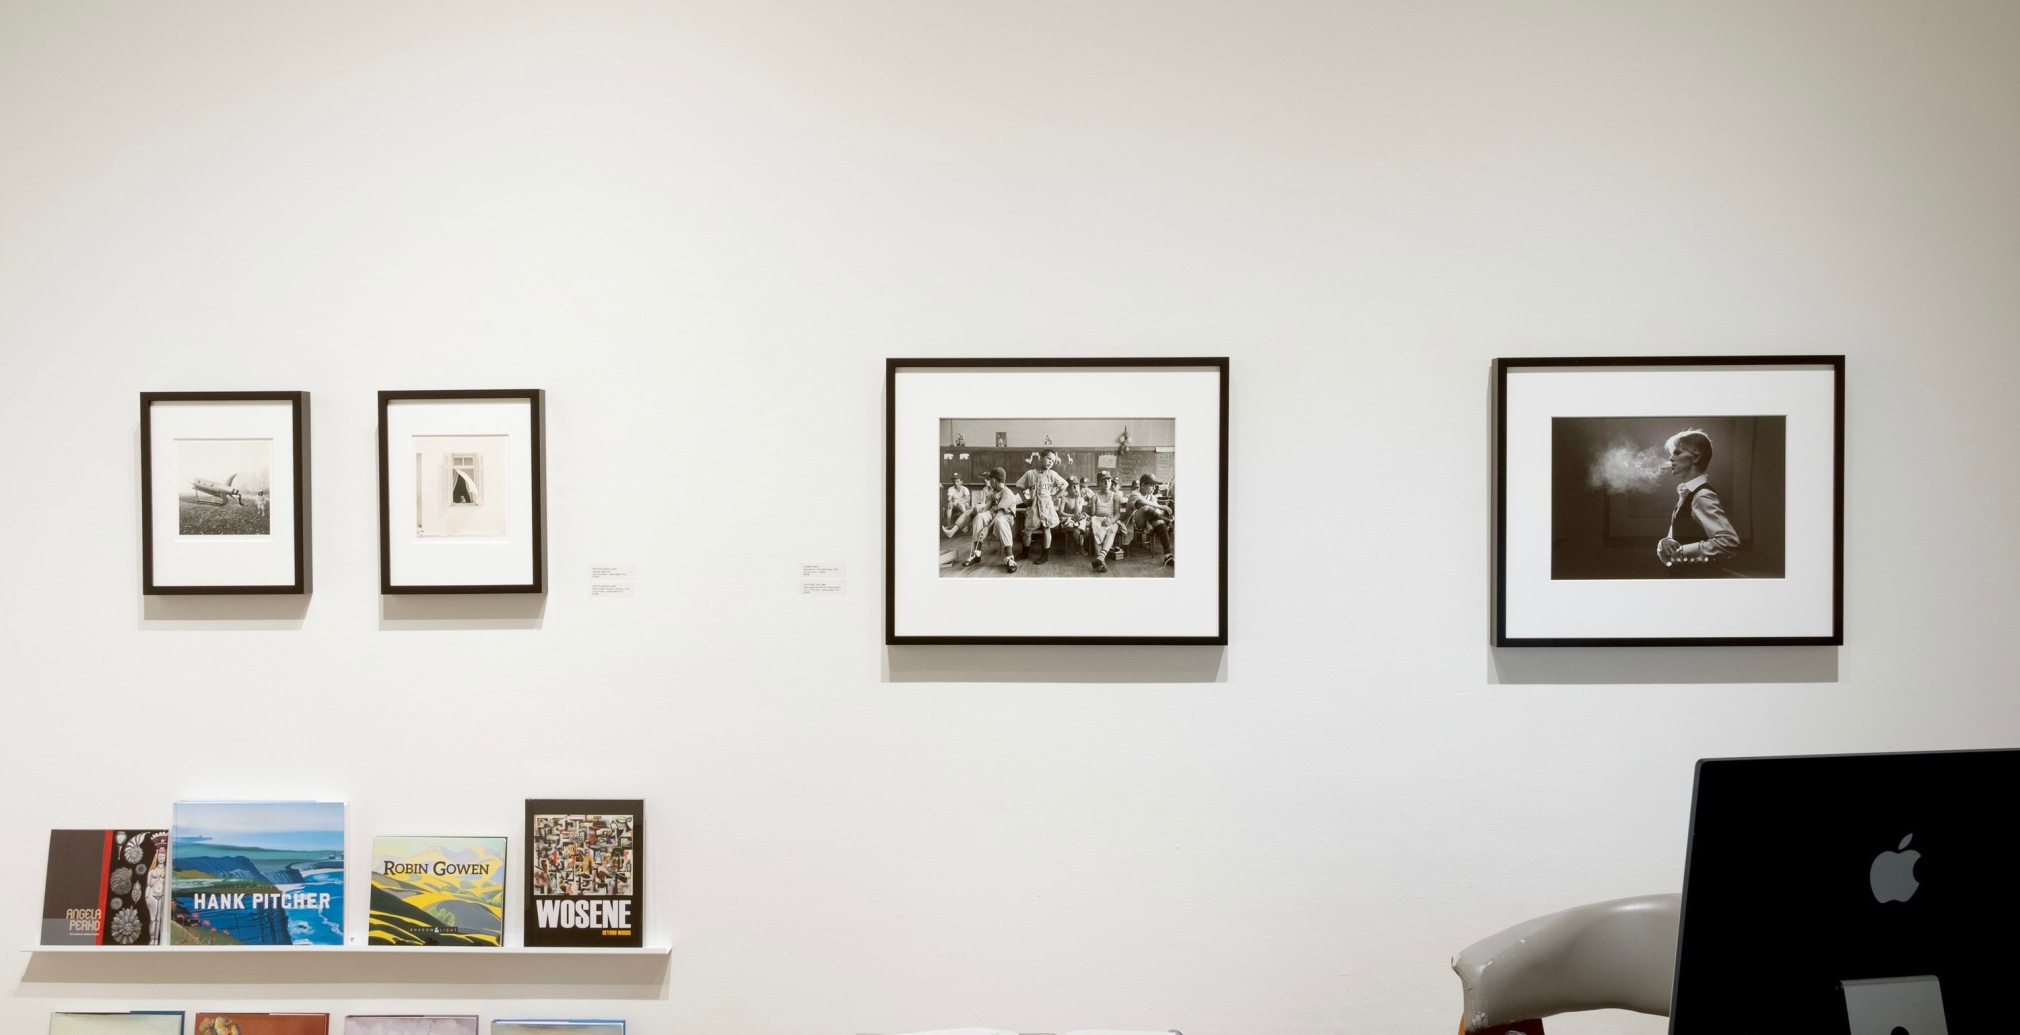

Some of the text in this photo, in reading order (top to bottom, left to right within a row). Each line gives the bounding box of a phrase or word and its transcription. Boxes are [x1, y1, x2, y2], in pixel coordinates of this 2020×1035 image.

[383, 860, 490, 876] ROBIN GOWEN
[194, 893, 331, 909] HANK PITCHER
[66, 908, 102, 919] ANGELA
[536, 899, 632, 928] WOSENE
[69, 919, 101, 931] PERKO
